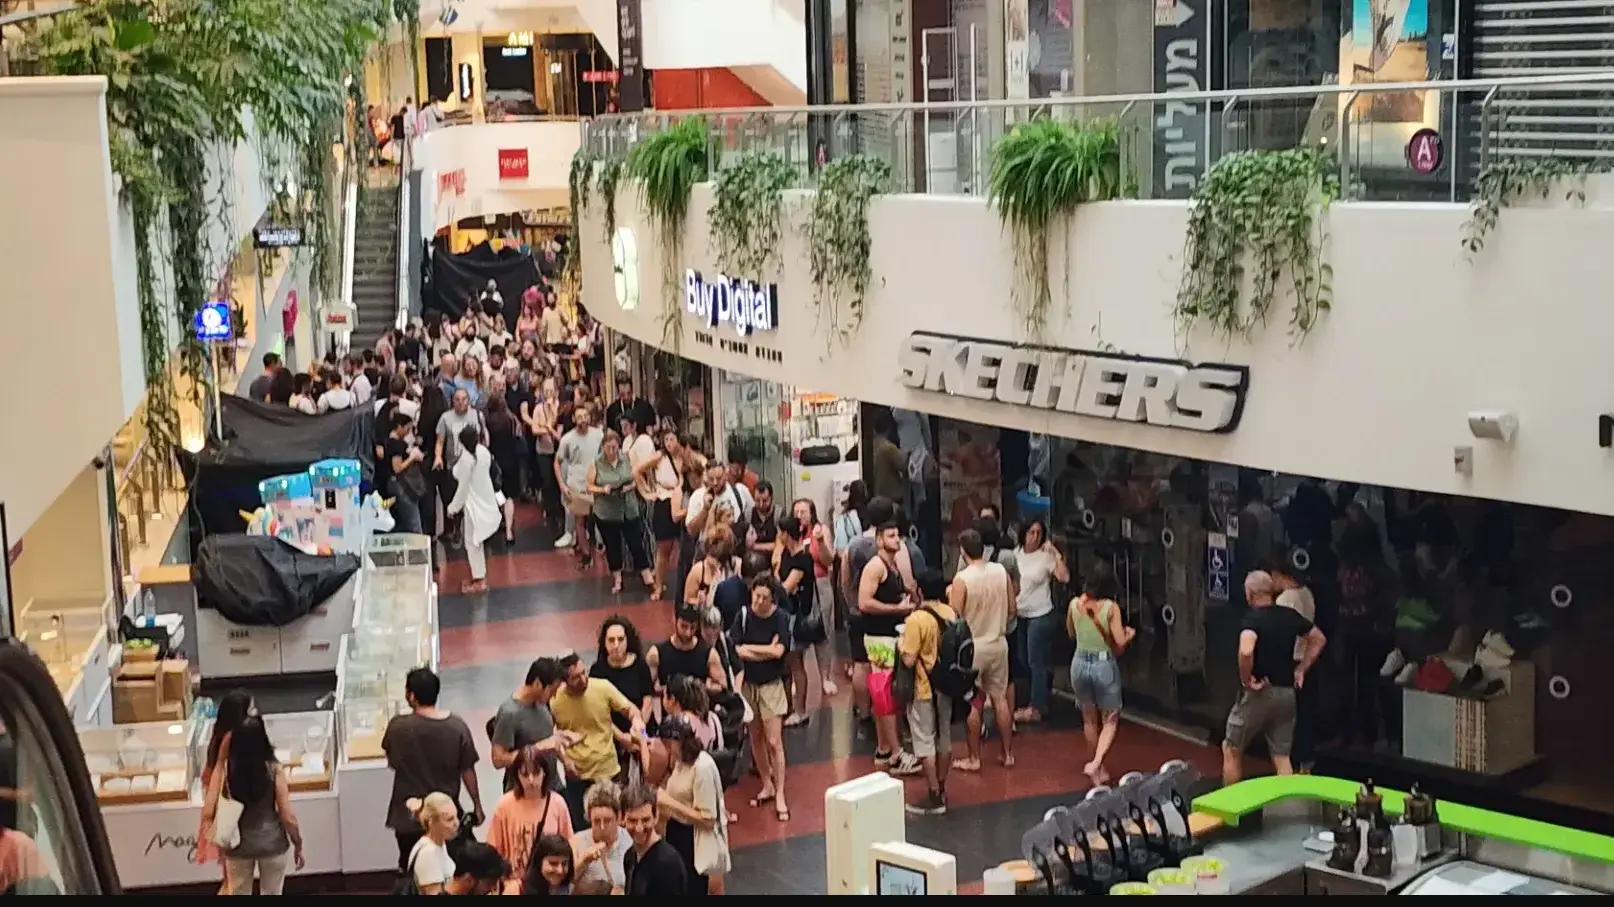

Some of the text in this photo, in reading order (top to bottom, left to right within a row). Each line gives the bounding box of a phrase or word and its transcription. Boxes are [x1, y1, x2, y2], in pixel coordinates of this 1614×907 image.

[1157, 37, 1200, 191] מעליות
[685, 267, 776, 337] Buy Digital
[898, 331, 1248, 433] SKECHERS
[144, 831, 199, 864] Mag
